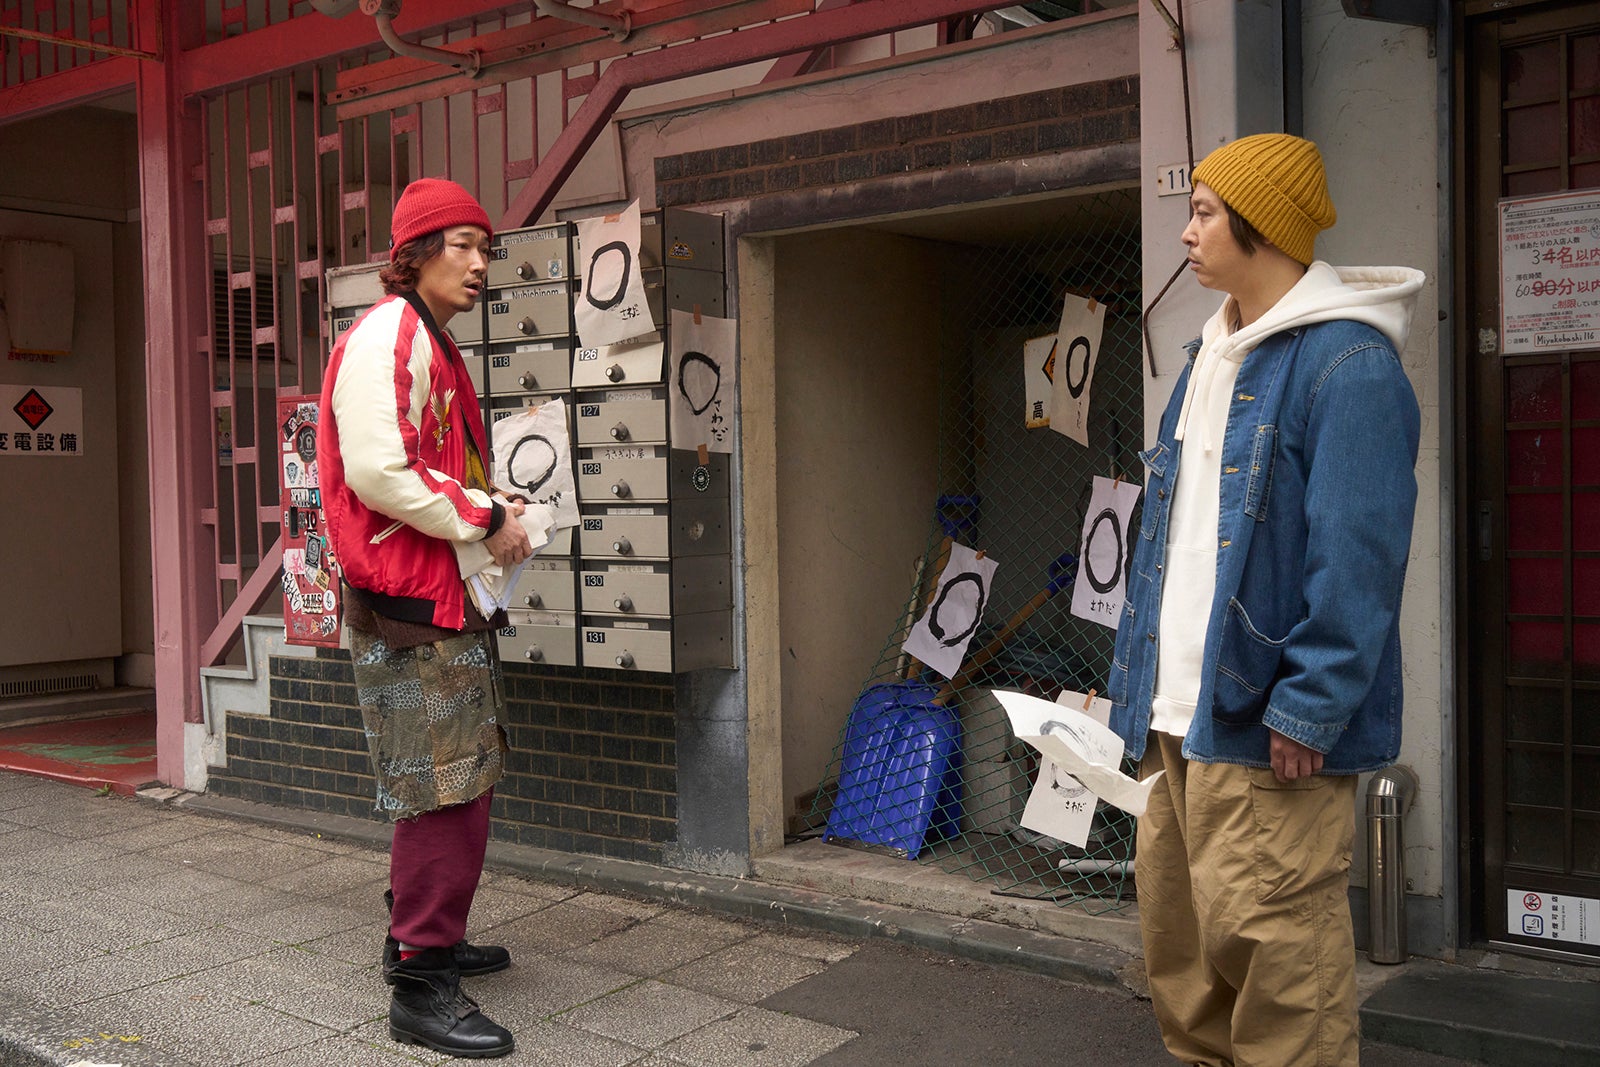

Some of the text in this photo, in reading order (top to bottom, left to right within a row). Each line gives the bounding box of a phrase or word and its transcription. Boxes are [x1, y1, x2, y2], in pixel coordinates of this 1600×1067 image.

[1168, 168, 1192, 189] 11
[492, 303, 508, 313] 117
[1584, 332, 1594, 340] 116
[579, 349, 597, 360] 126
[493, 357, 509, 367] 118
[582, 406, 599, 416] 127
[711, 400, 728, 442] さわだ
[583, 463, 600, 474] 128
[585, 520, 602, 530] 129
[586, 576, 603, 586] 130
[501, 627, 516, 637] 123
[587, 633, 604, 642] 131
[1065, 801, 1087, 813] さわだ
